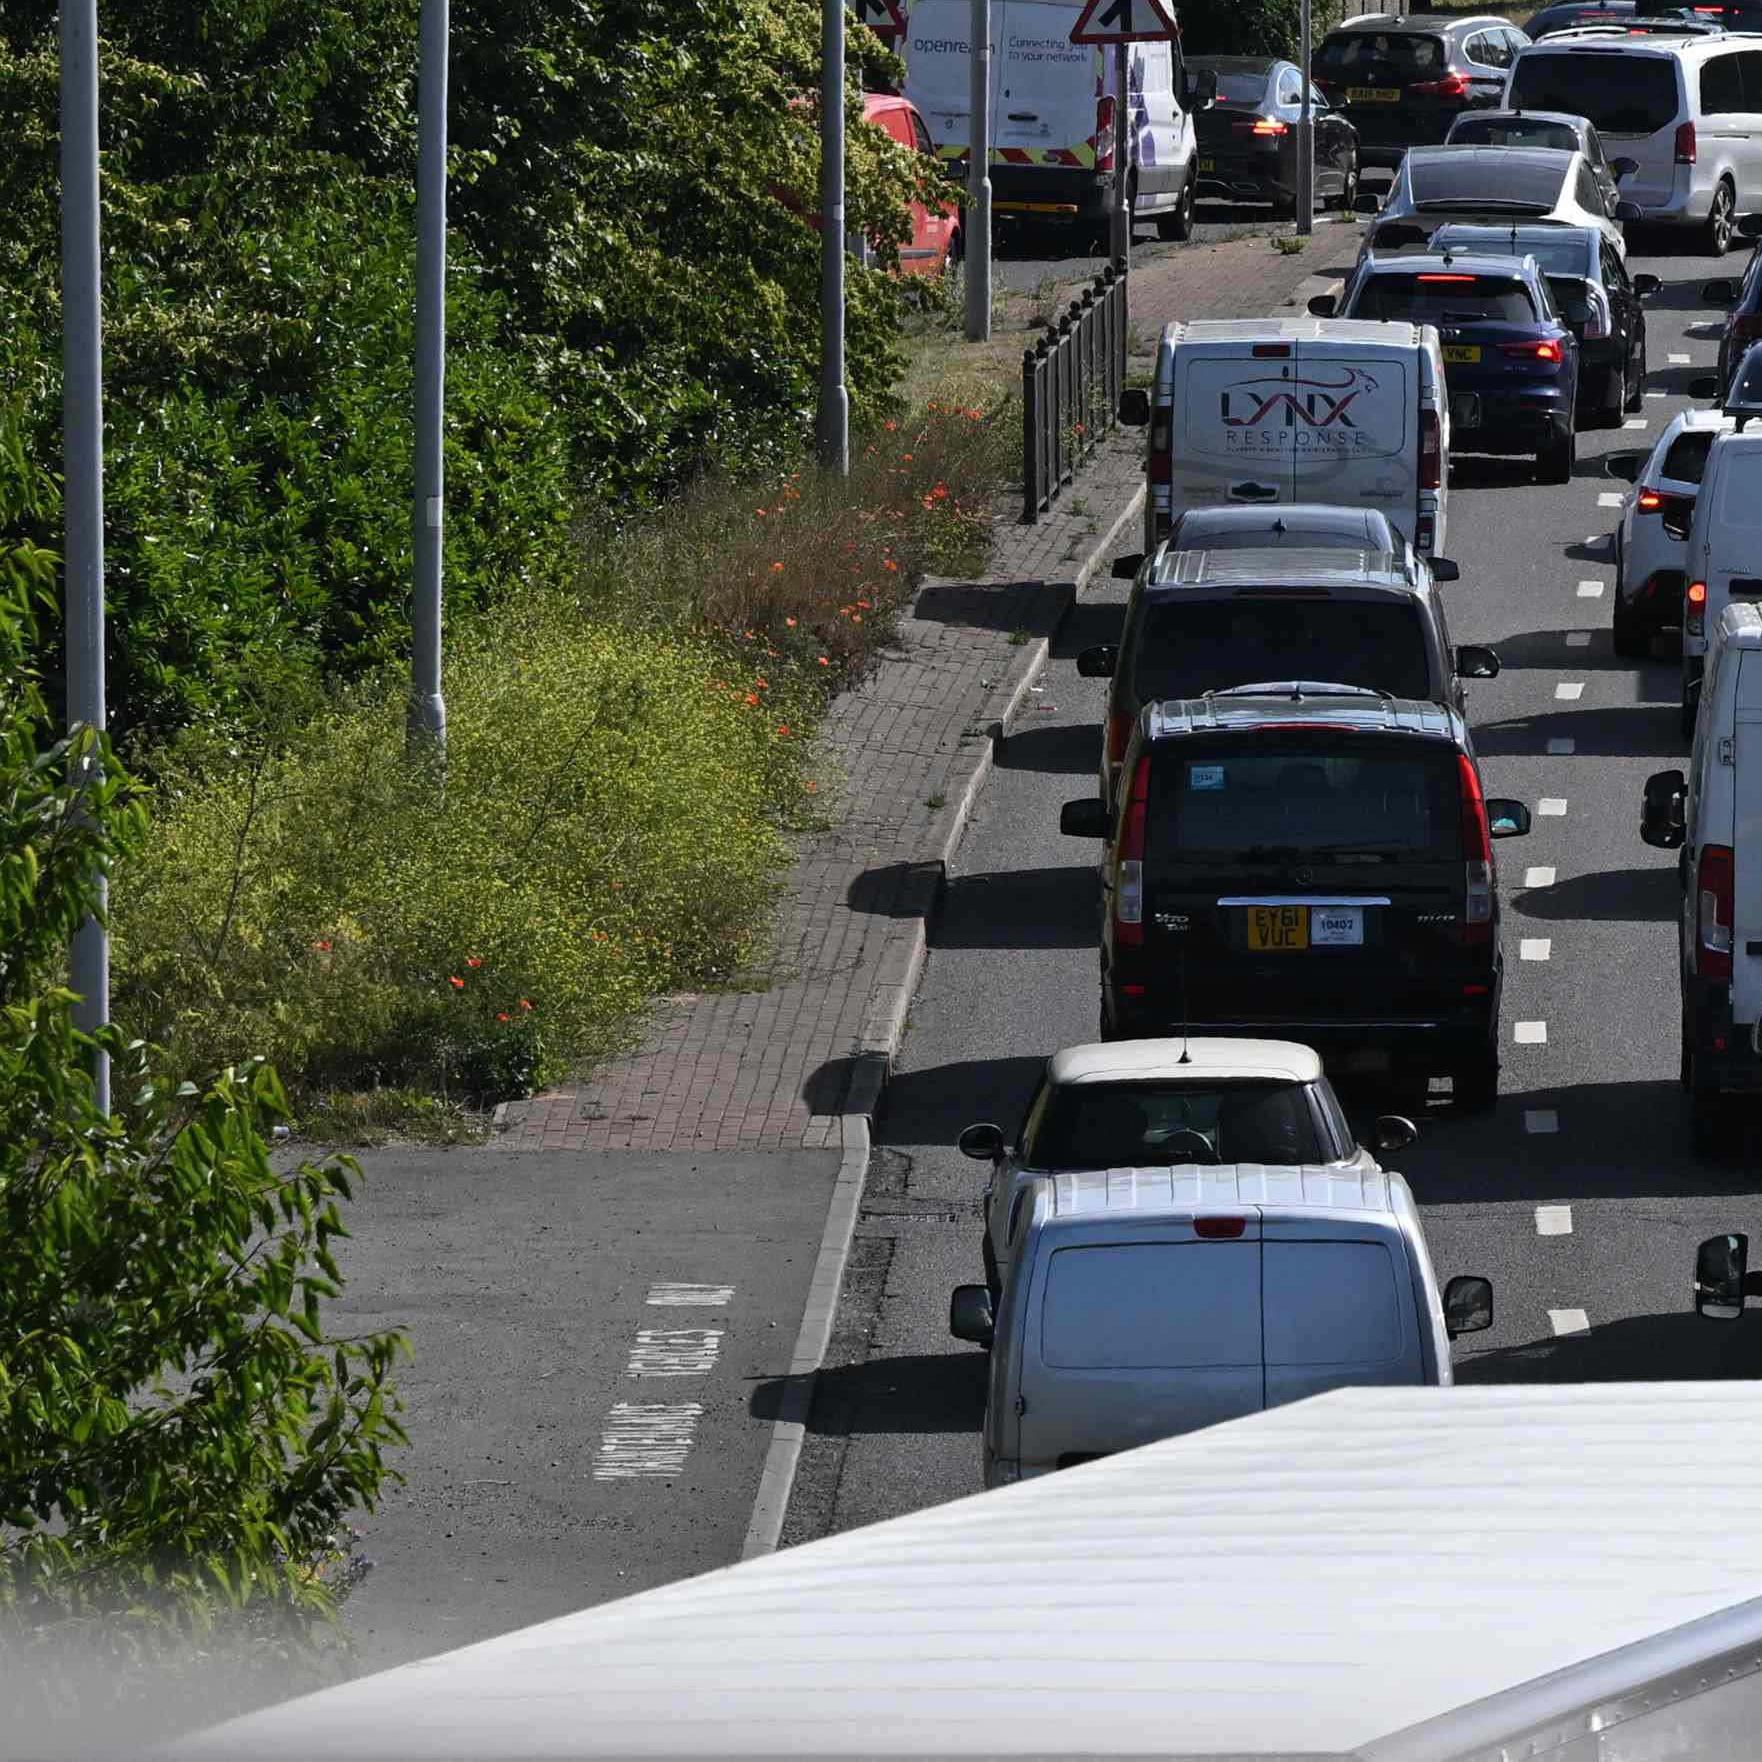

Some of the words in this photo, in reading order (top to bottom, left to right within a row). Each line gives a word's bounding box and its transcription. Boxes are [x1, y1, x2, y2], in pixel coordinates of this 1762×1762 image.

[1008, 36, 1066, 51] Connecting
[1008, 50, 1021, 61] to
[1023, 52, 1047, 63] your
[1048, 52, 1087, 62] network
[1221, 392, 1361, 427] LYNX
[1226, 430, 1372, 446] RESPONSE
[1255, 908, 1300, 928] EY61
[1258, 928, 1298, 947] VUC
